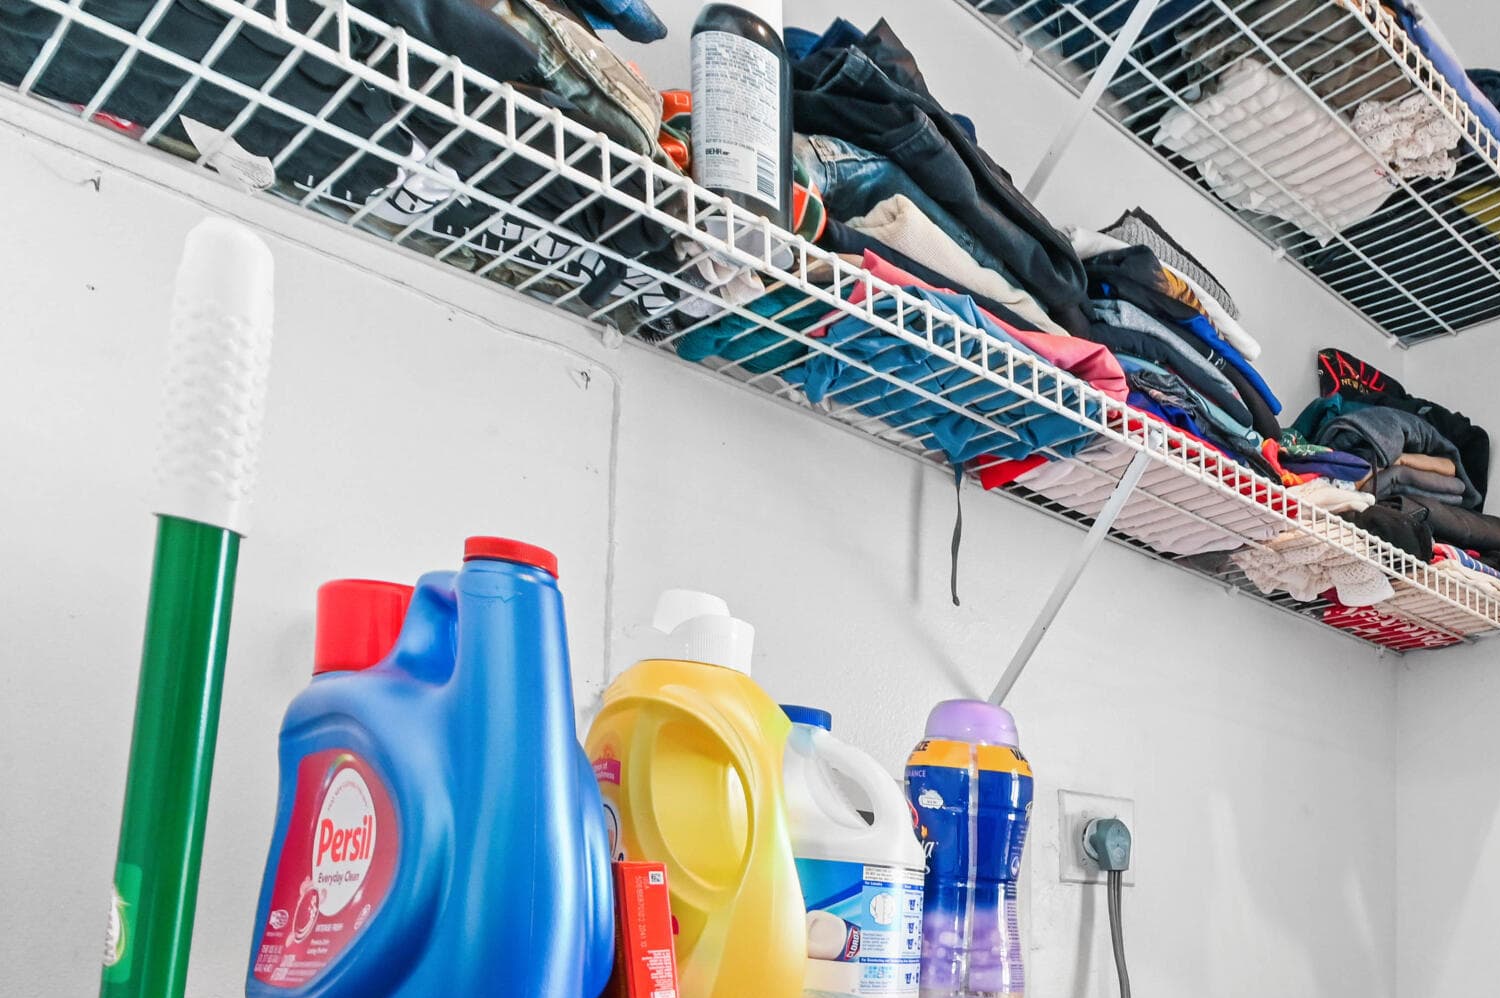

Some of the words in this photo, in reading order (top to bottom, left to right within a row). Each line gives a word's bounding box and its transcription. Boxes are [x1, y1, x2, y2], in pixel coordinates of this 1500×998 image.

[316, 814, 373, 866] Persil
[318, 872, 344, 886] Everyday
[344, 871, 360, 883] Clean
